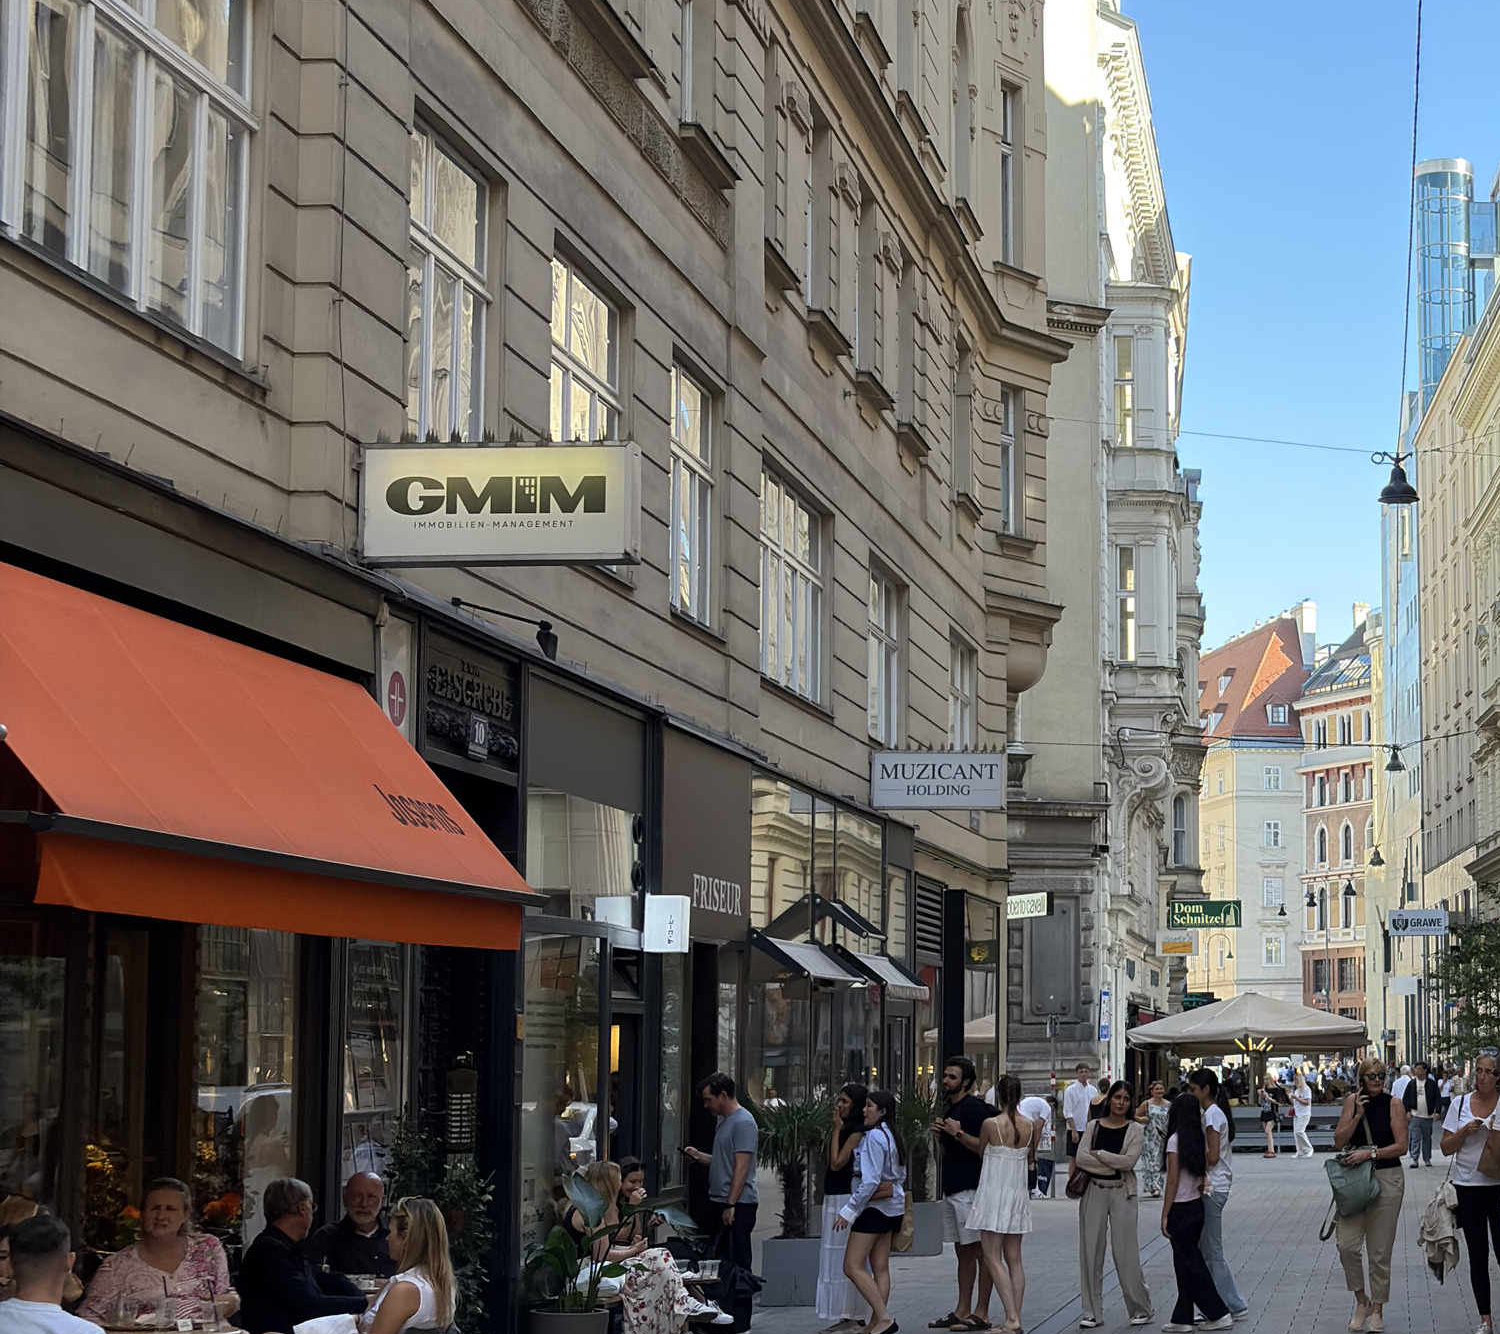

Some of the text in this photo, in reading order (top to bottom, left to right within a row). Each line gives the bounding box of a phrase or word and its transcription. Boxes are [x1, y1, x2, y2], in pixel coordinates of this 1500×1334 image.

[413, 519, 574, 530] IMMOBILIEN-MANAGEMENT
[474, 720, 485, 745] 10
[880, 763, 999, 780] MUZICANT
[906, 784, 971, 796] HOLDING
[692, 873, 743, 916] FRISEUR
[1007, 898, 1026, 916] oberto
[1174, 902, 1203, 914] Dom
[1173, 912, 1224, 924] Schnitzel
[1410, 917, 1442, 927] GRAWE
